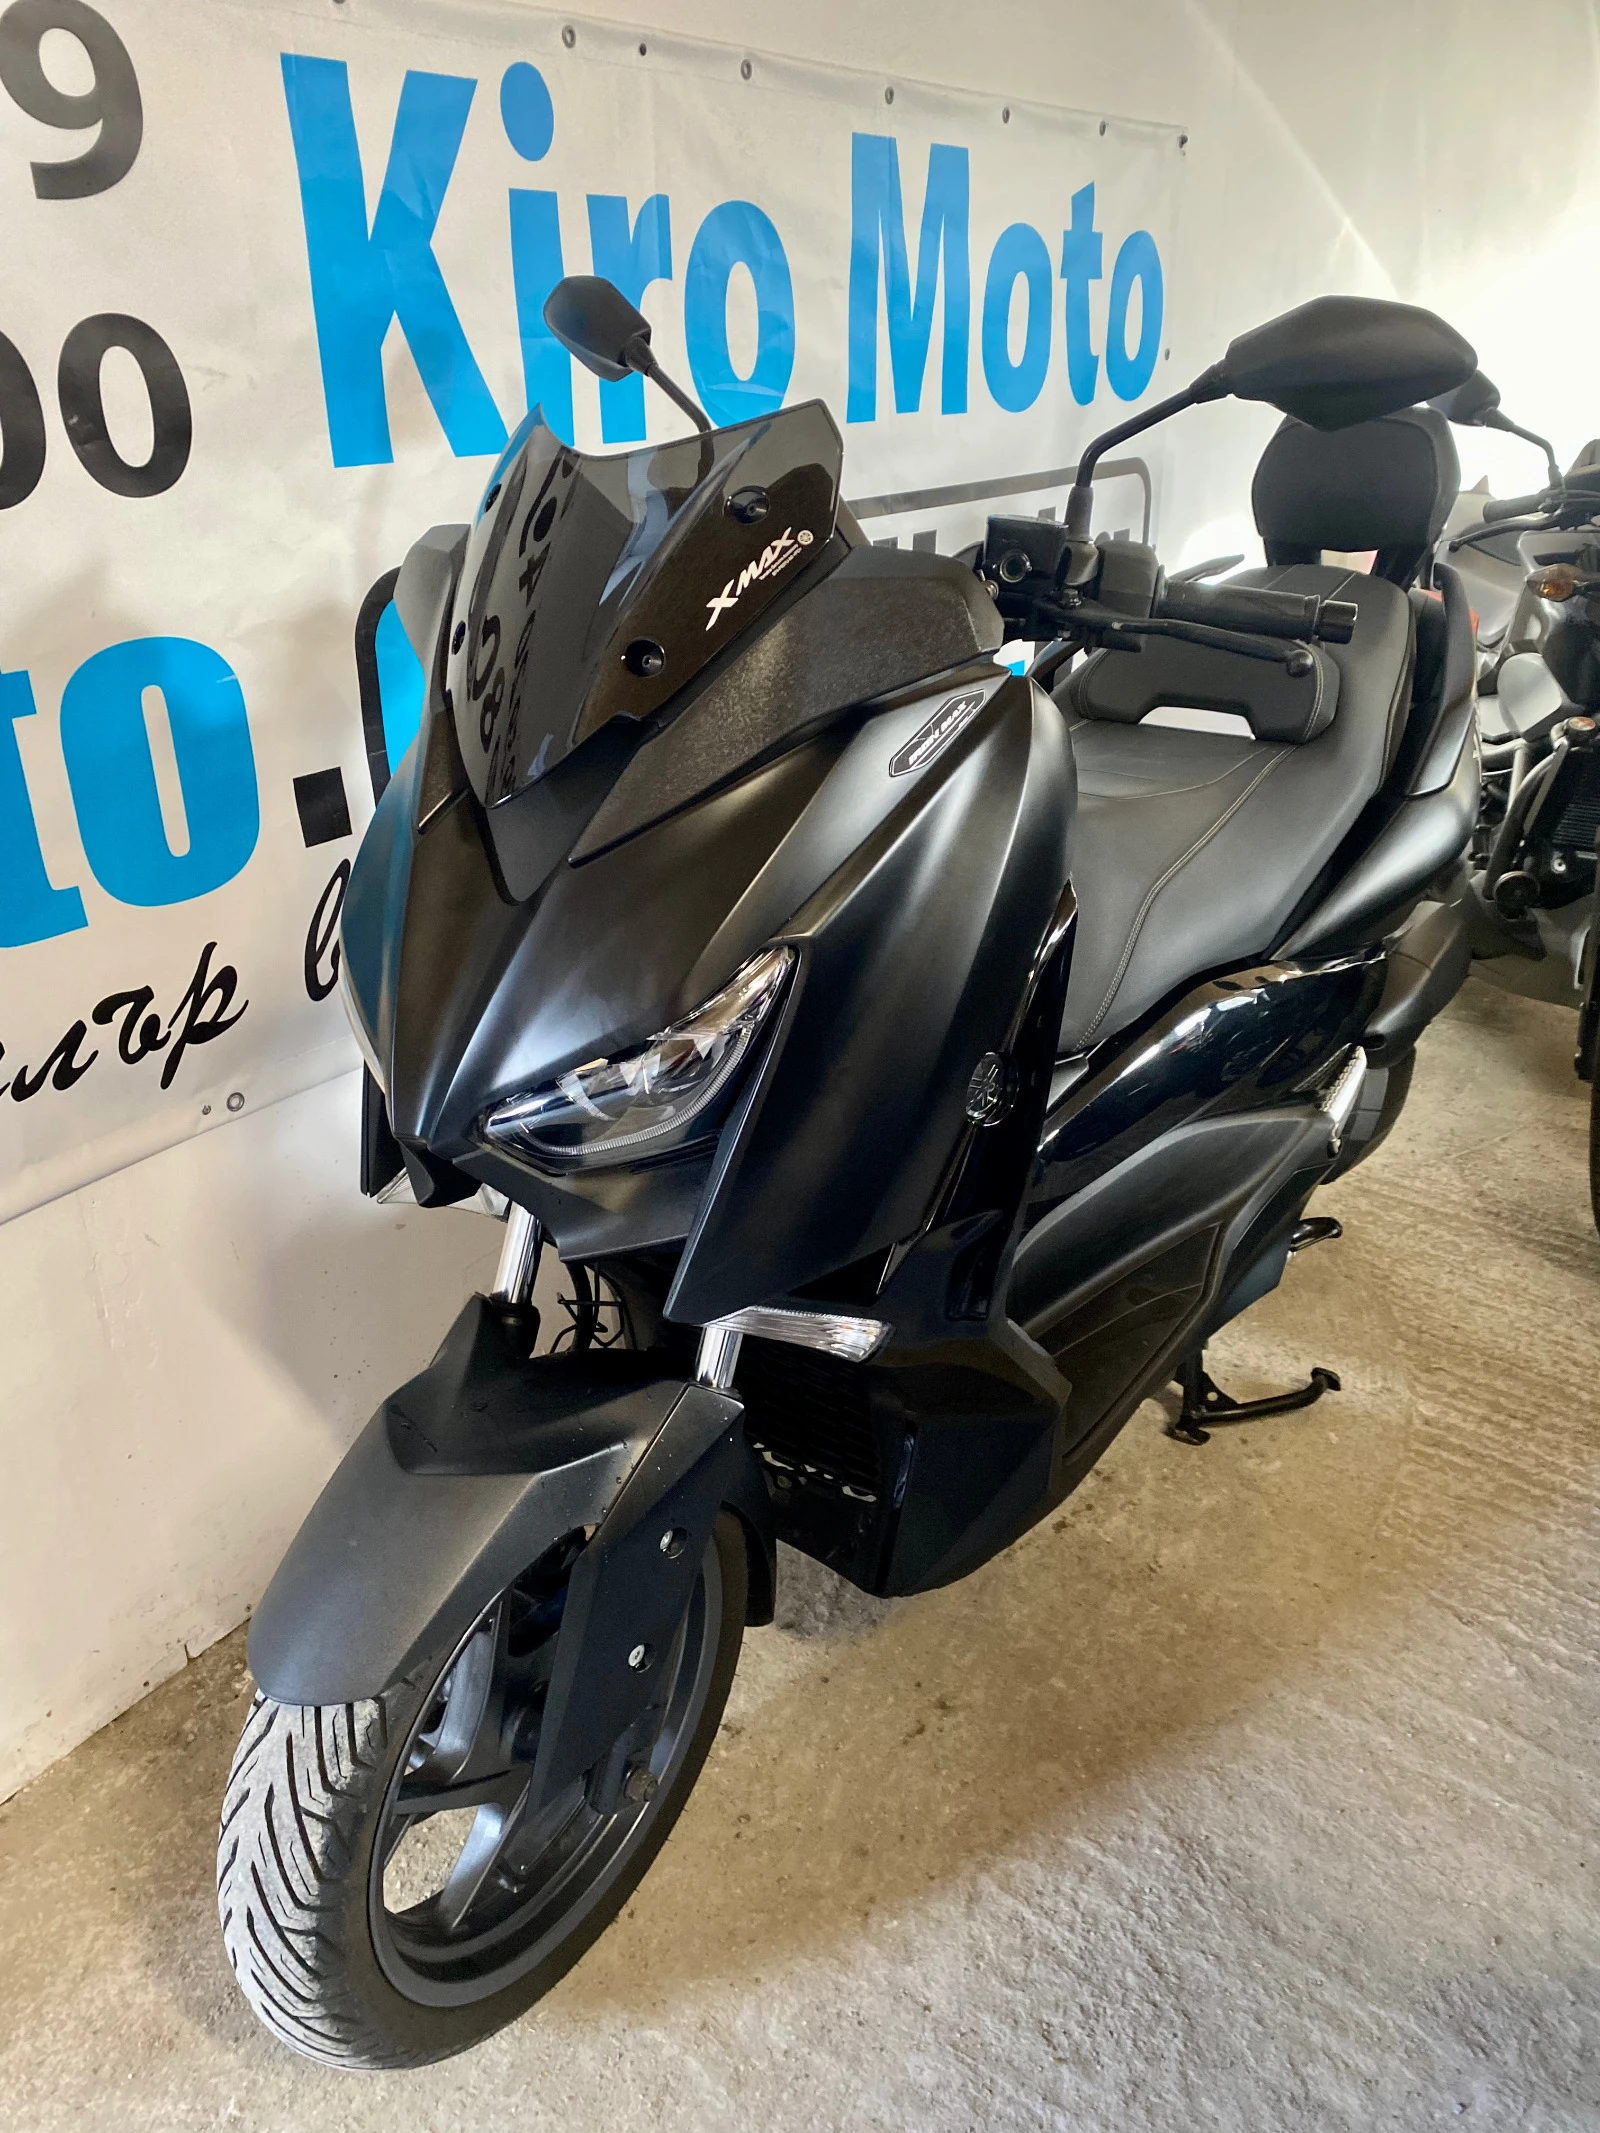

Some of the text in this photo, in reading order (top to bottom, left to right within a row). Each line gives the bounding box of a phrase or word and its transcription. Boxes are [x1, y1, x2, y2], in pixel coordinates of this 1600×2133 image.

[0, 0, 143, 200] 9
[280, 52, 1163, 468] Kiro Moto
